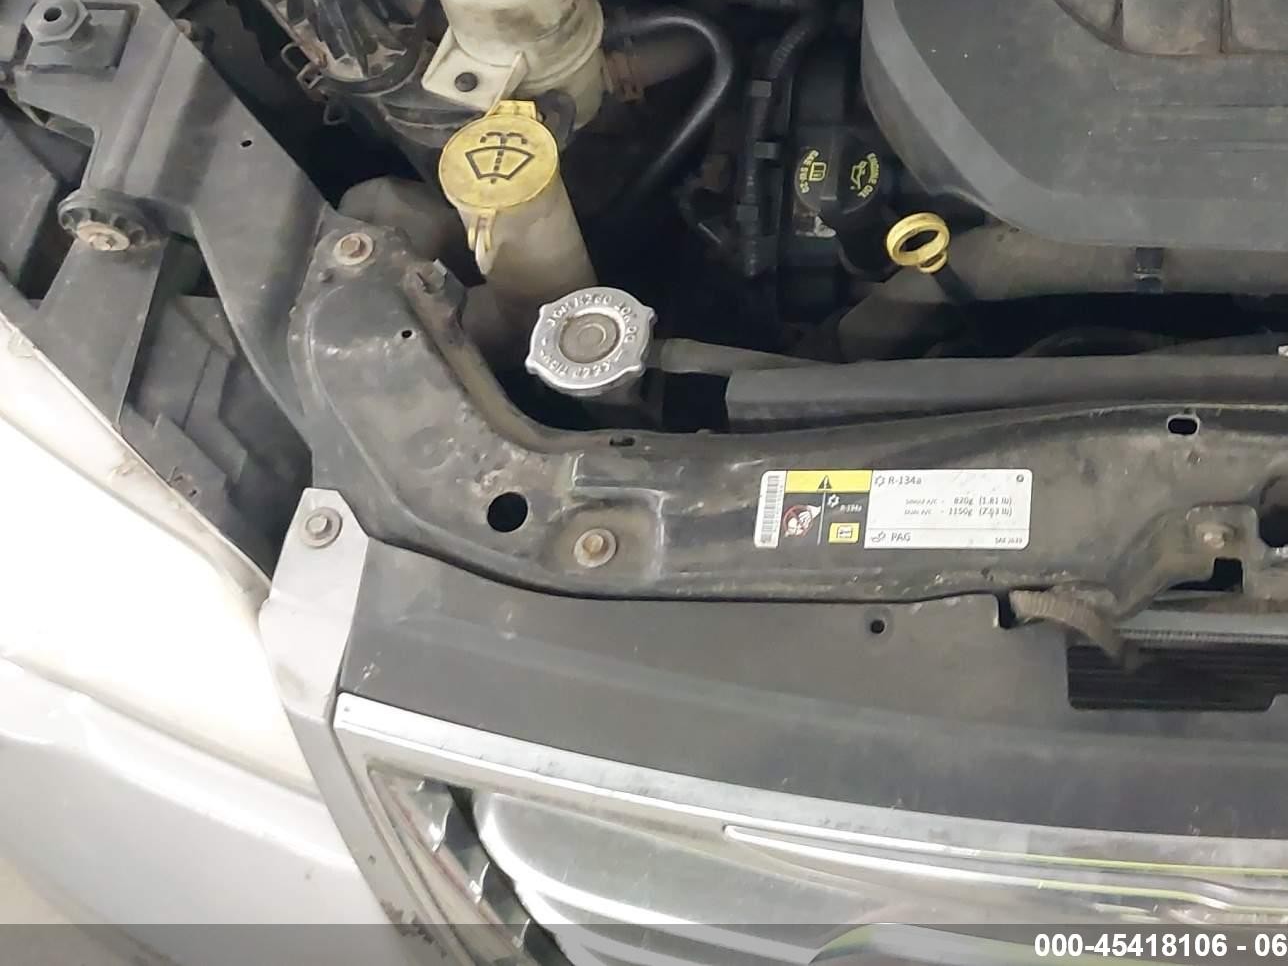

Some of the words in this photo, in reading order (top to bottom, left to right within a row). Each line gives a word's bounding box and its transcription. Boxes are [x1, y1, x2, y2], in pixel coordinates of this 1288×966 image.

[857, 185, 874, 198] OIL
[888, 475, 922, 485] R-134a
[953, 497, 974, 506] 820g
[949, 507, 973, 517] 1150g
[890, 532, 911, 542] PAG
